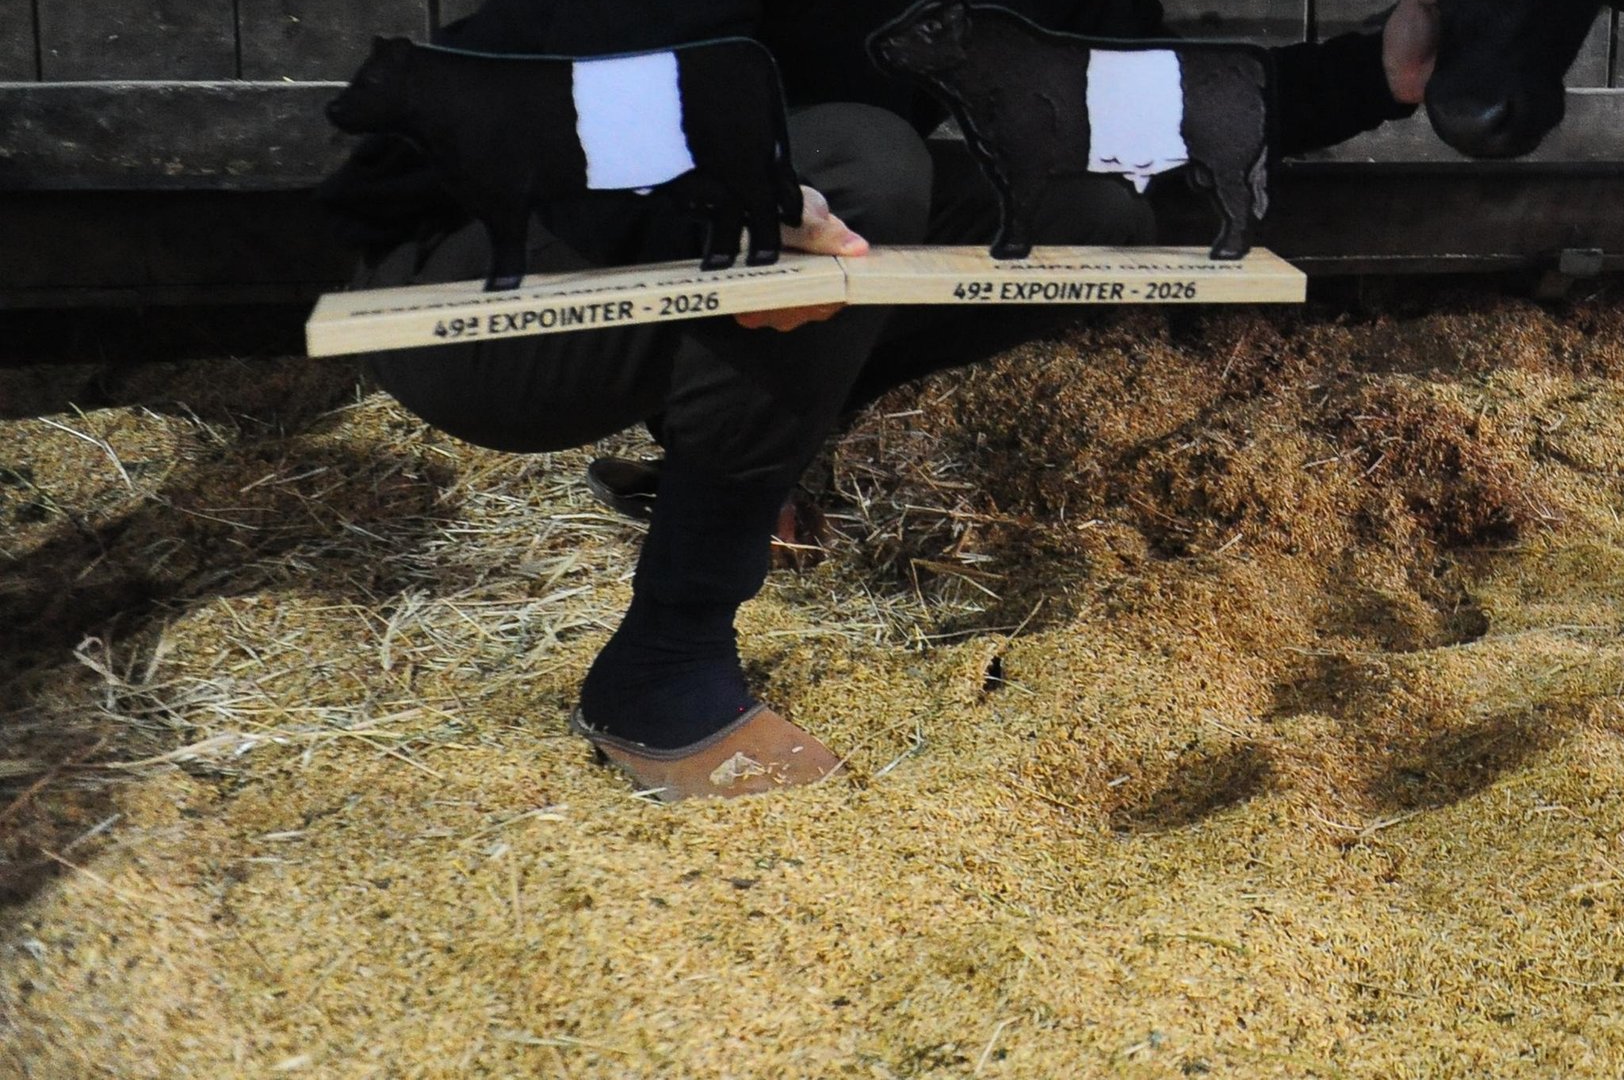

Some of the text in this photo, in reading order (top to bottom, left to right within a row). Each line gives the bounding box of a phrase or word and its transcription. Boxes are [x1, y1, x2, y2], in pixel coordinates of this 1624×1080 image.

[953, 281, 993, 300] 49ª
[1000, 281, 1124, 300] EXPOINTER
[1146, 281, 1196, 299] 2026
[433, 316, 479, 339] 49ª
[487, 300, 635, 334] EXPOINTER
[660, 292, 721, 316] 2026
